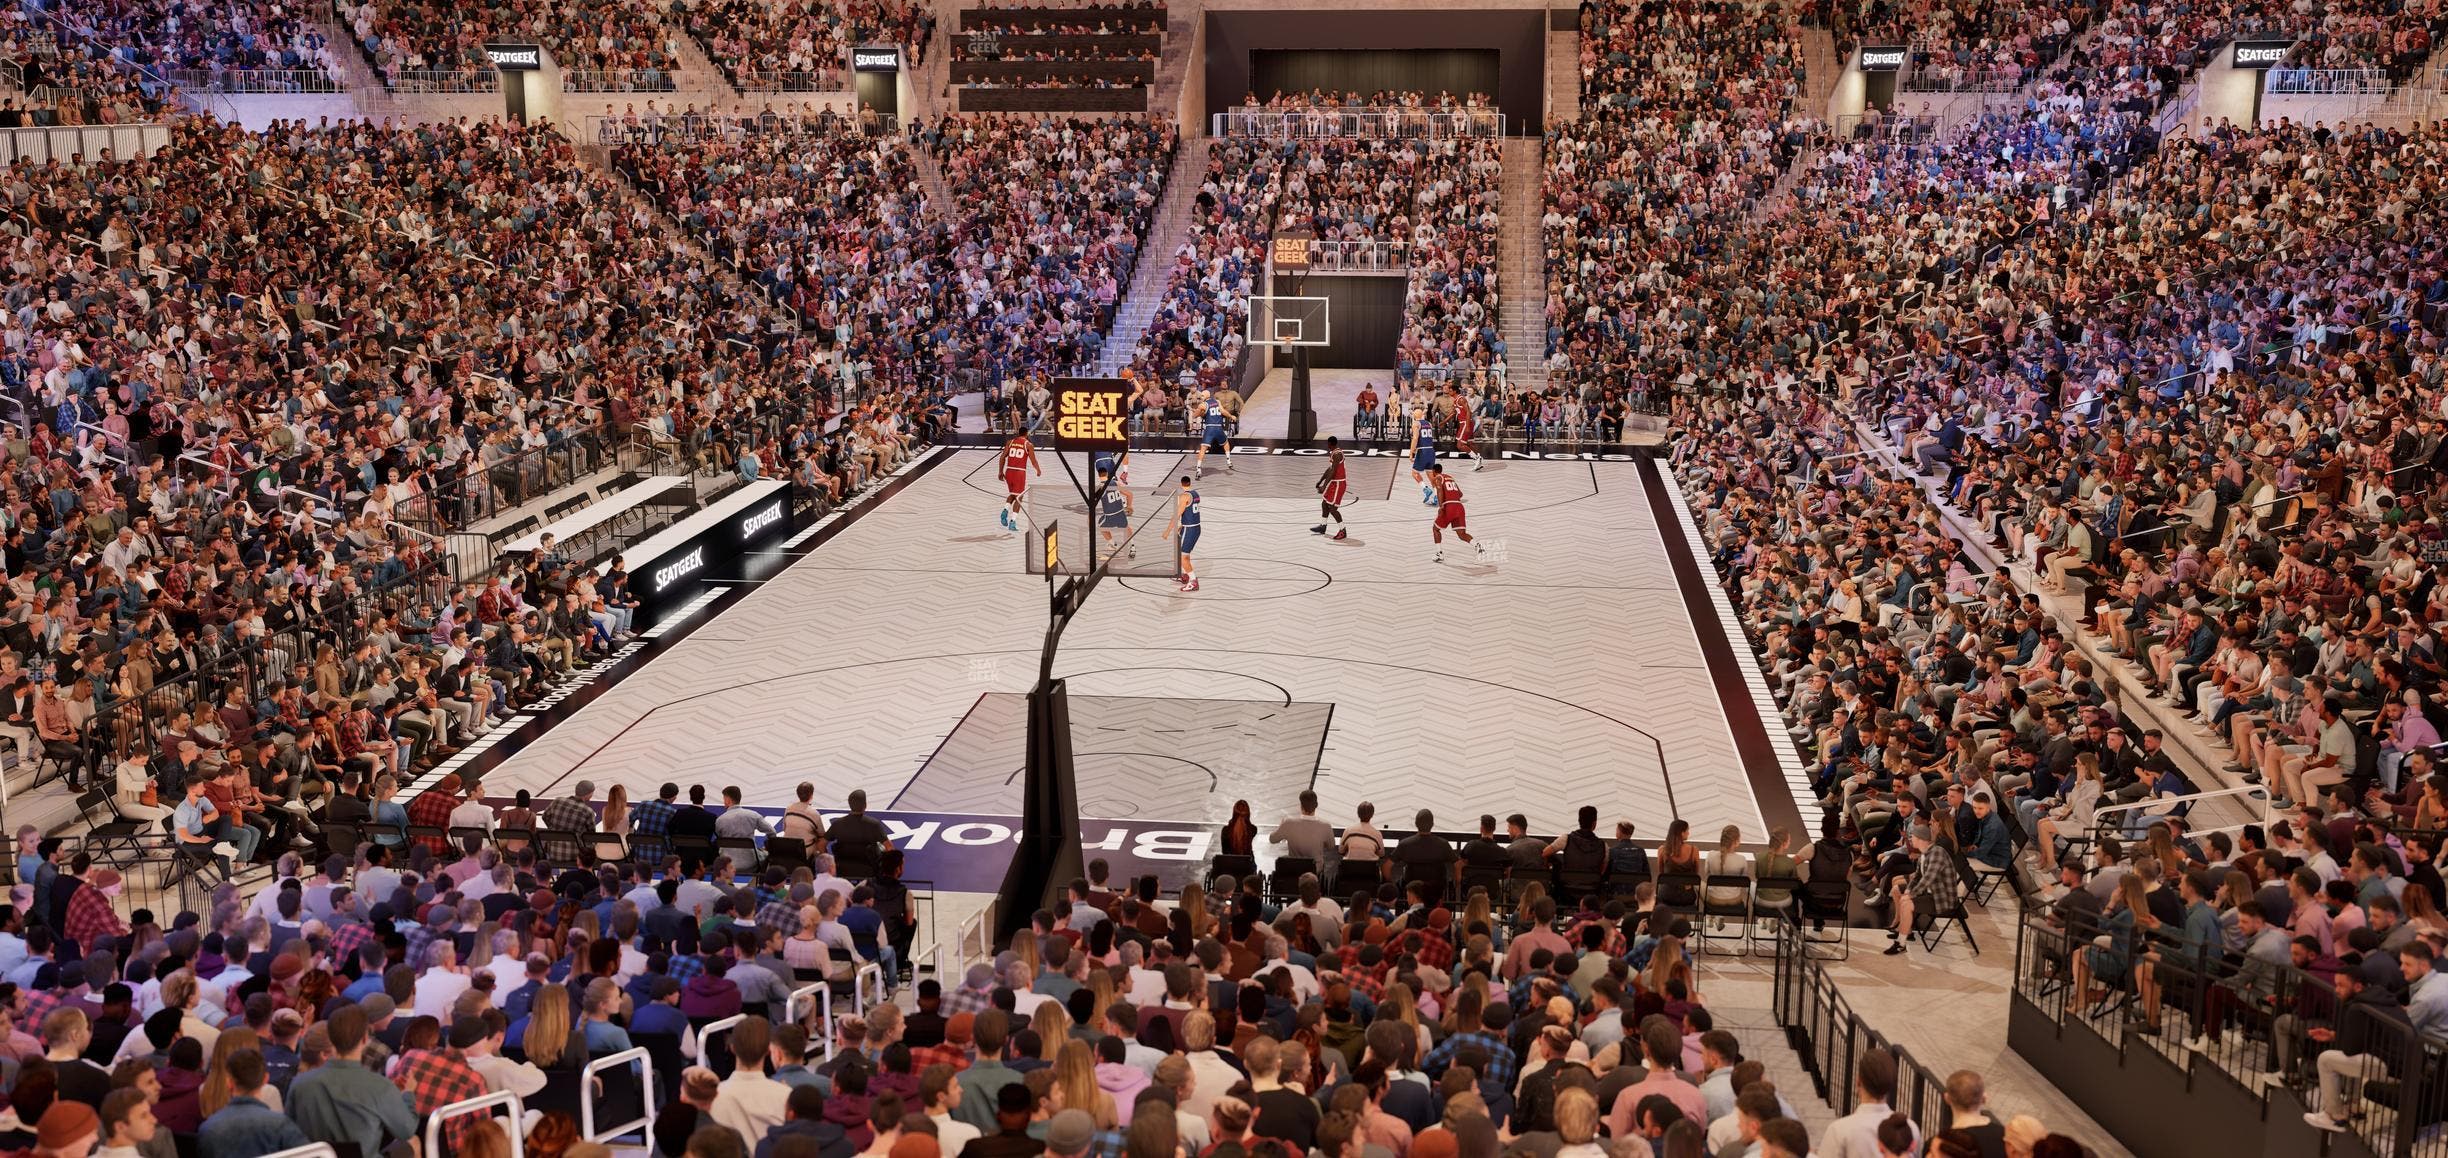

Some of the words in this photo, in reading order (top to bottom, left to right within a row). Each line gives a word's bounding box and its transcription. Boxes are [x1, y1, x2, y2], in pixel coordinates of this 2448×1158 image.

[855, 53, 897, 67] SEATGEEK
[1863, 51, 1905, 65] SEATGEEK
[1275, 238, 1308, 250] SEAT
[1274, 251, 1310, 264] GEEK
[1060, 390, 1123, 415] SEAT
[1209, 407, 1222, 416] 00
[1057, 416, 1126, 440] GEEK
[1420, 428, 1432, 438] 00
[1008, 447, 1025, 458] 00
[1502, 450, 1633, 461] Nets
[1107, 490, 1121, 503] 00
[743, 500, 782, 539] SEATGEEK
[655, 546, 704, 592] SEATGEEK
